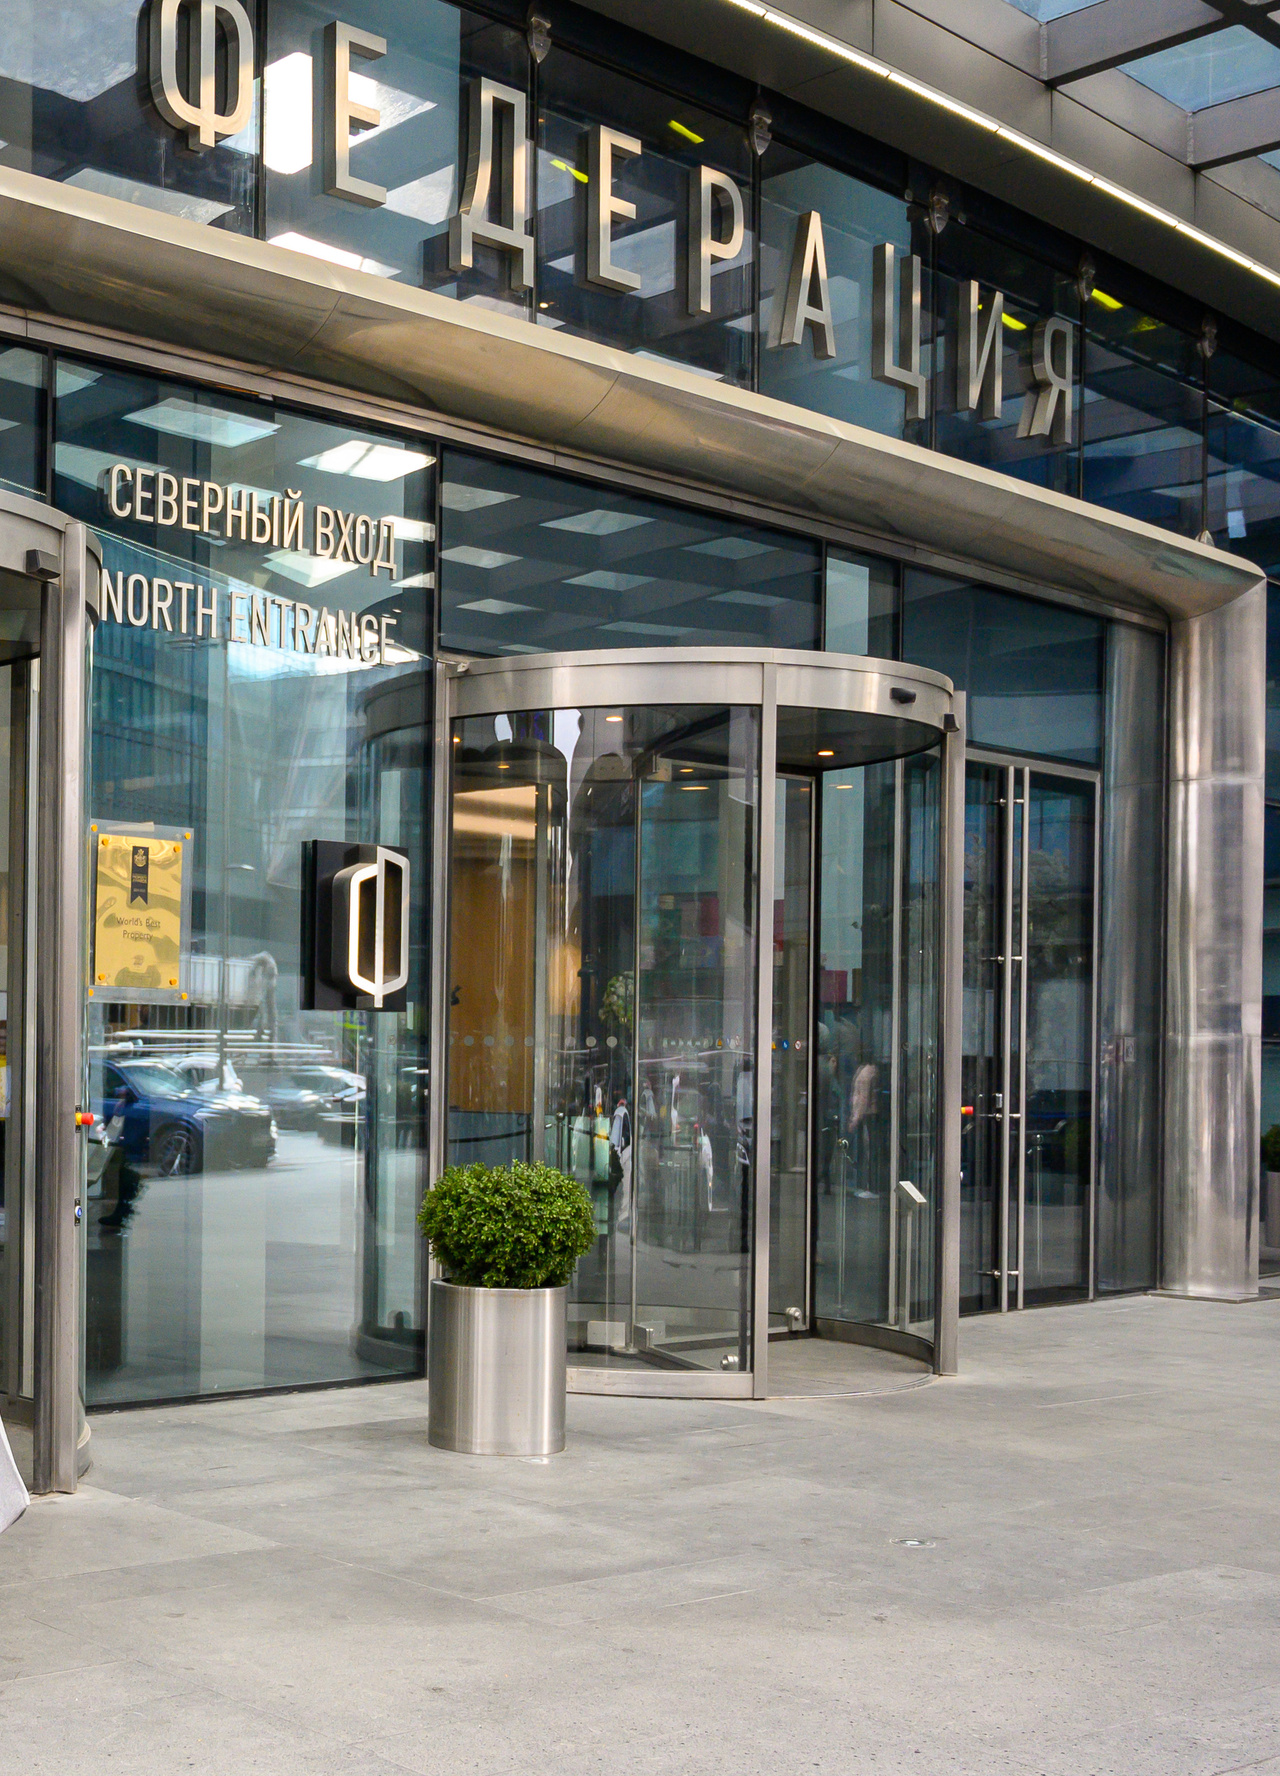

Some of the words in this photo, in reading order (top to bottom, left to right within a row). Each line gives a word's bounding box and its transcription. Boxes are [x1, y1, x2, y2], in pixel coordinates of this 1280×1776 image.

[150, 0, 1074, 445] ФЕДЕРАЦИЯ
[109, 463, 305, 551] СЕВЕРНЫЙ
[316, 504, 397, 580] ВХОД
[101, 568, 218, 639] NORTH
[229, 590, 397, 667] ENTRANCE
[117, 917, 143, 927] World's
[145, 918, 161, 928] Best
[123, 929, 154, 942] Property
